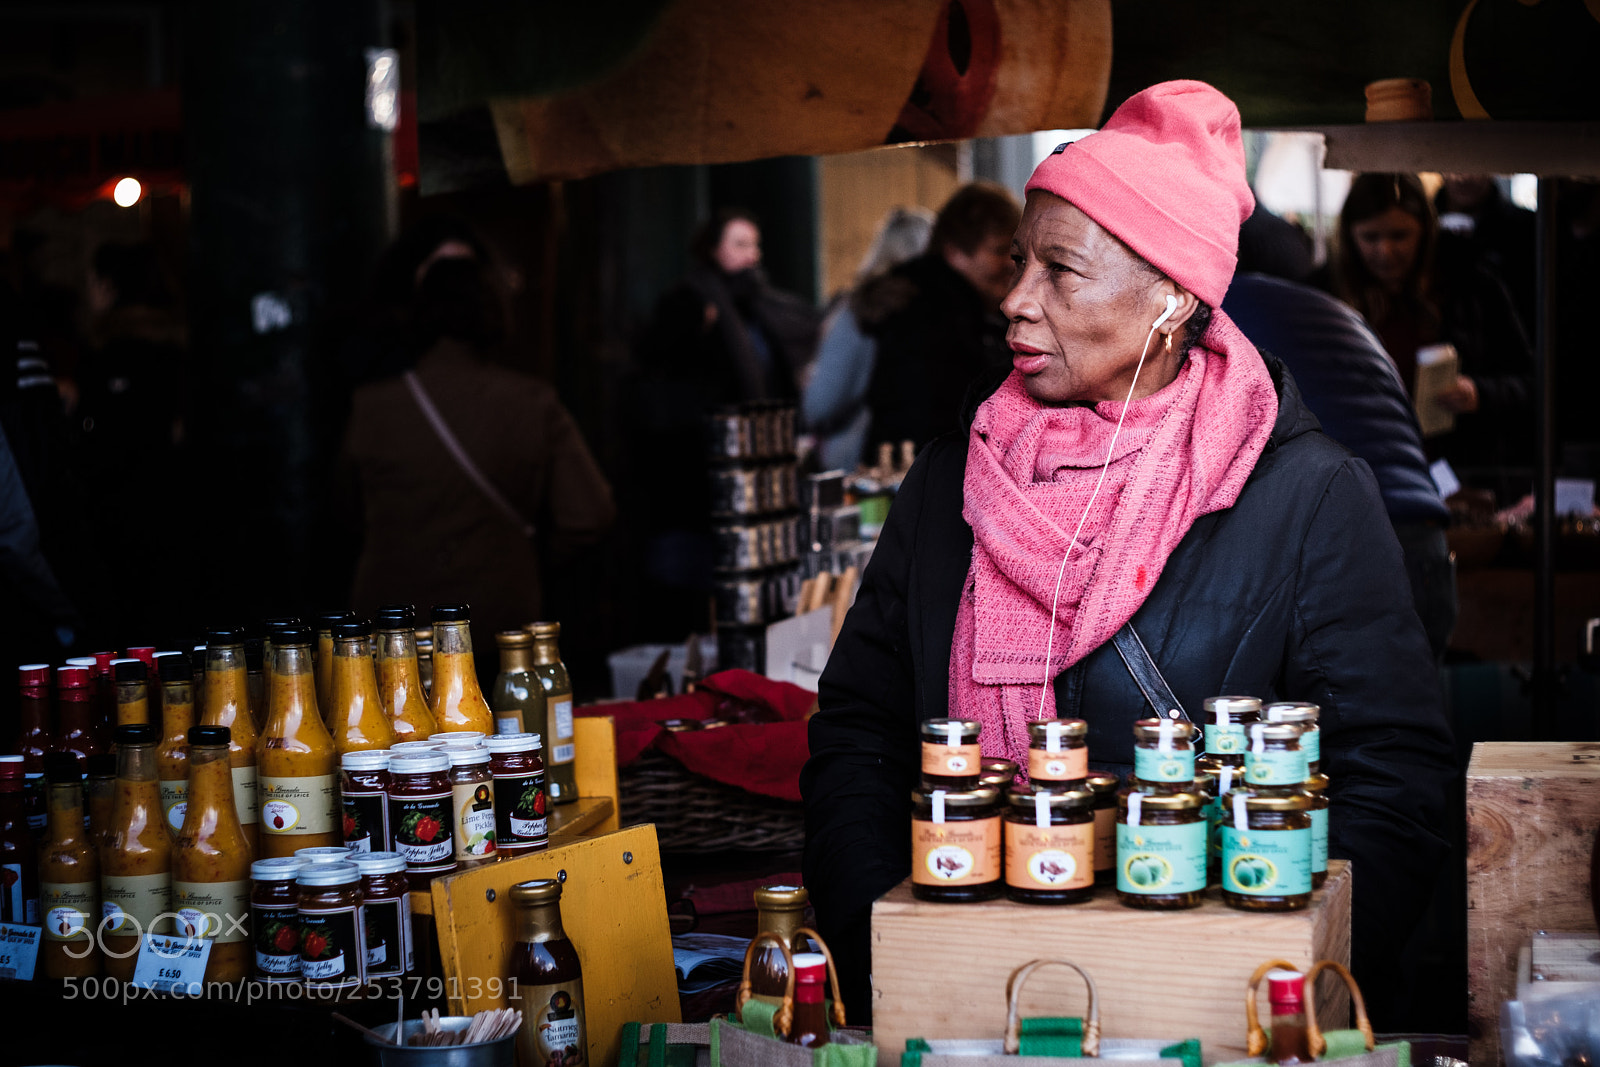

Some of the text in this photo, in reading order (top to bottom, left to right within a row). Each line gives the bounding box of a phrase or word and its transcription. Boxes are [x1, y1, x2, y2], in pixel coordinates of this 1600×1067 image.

[461, 812, 495, 825] Lime Pepp
[474, 821, 493, 831] Pickle
[521, 822, 542, 831] Pepper
[403, 847, 427, 857] Pepper
[428, 844, 445, 857] Jelly
[263, 958, 286, 967] Pepper
[316, 962, 333, 973] Jelly
[547, 1023, 578, 1034] Nutmeg
